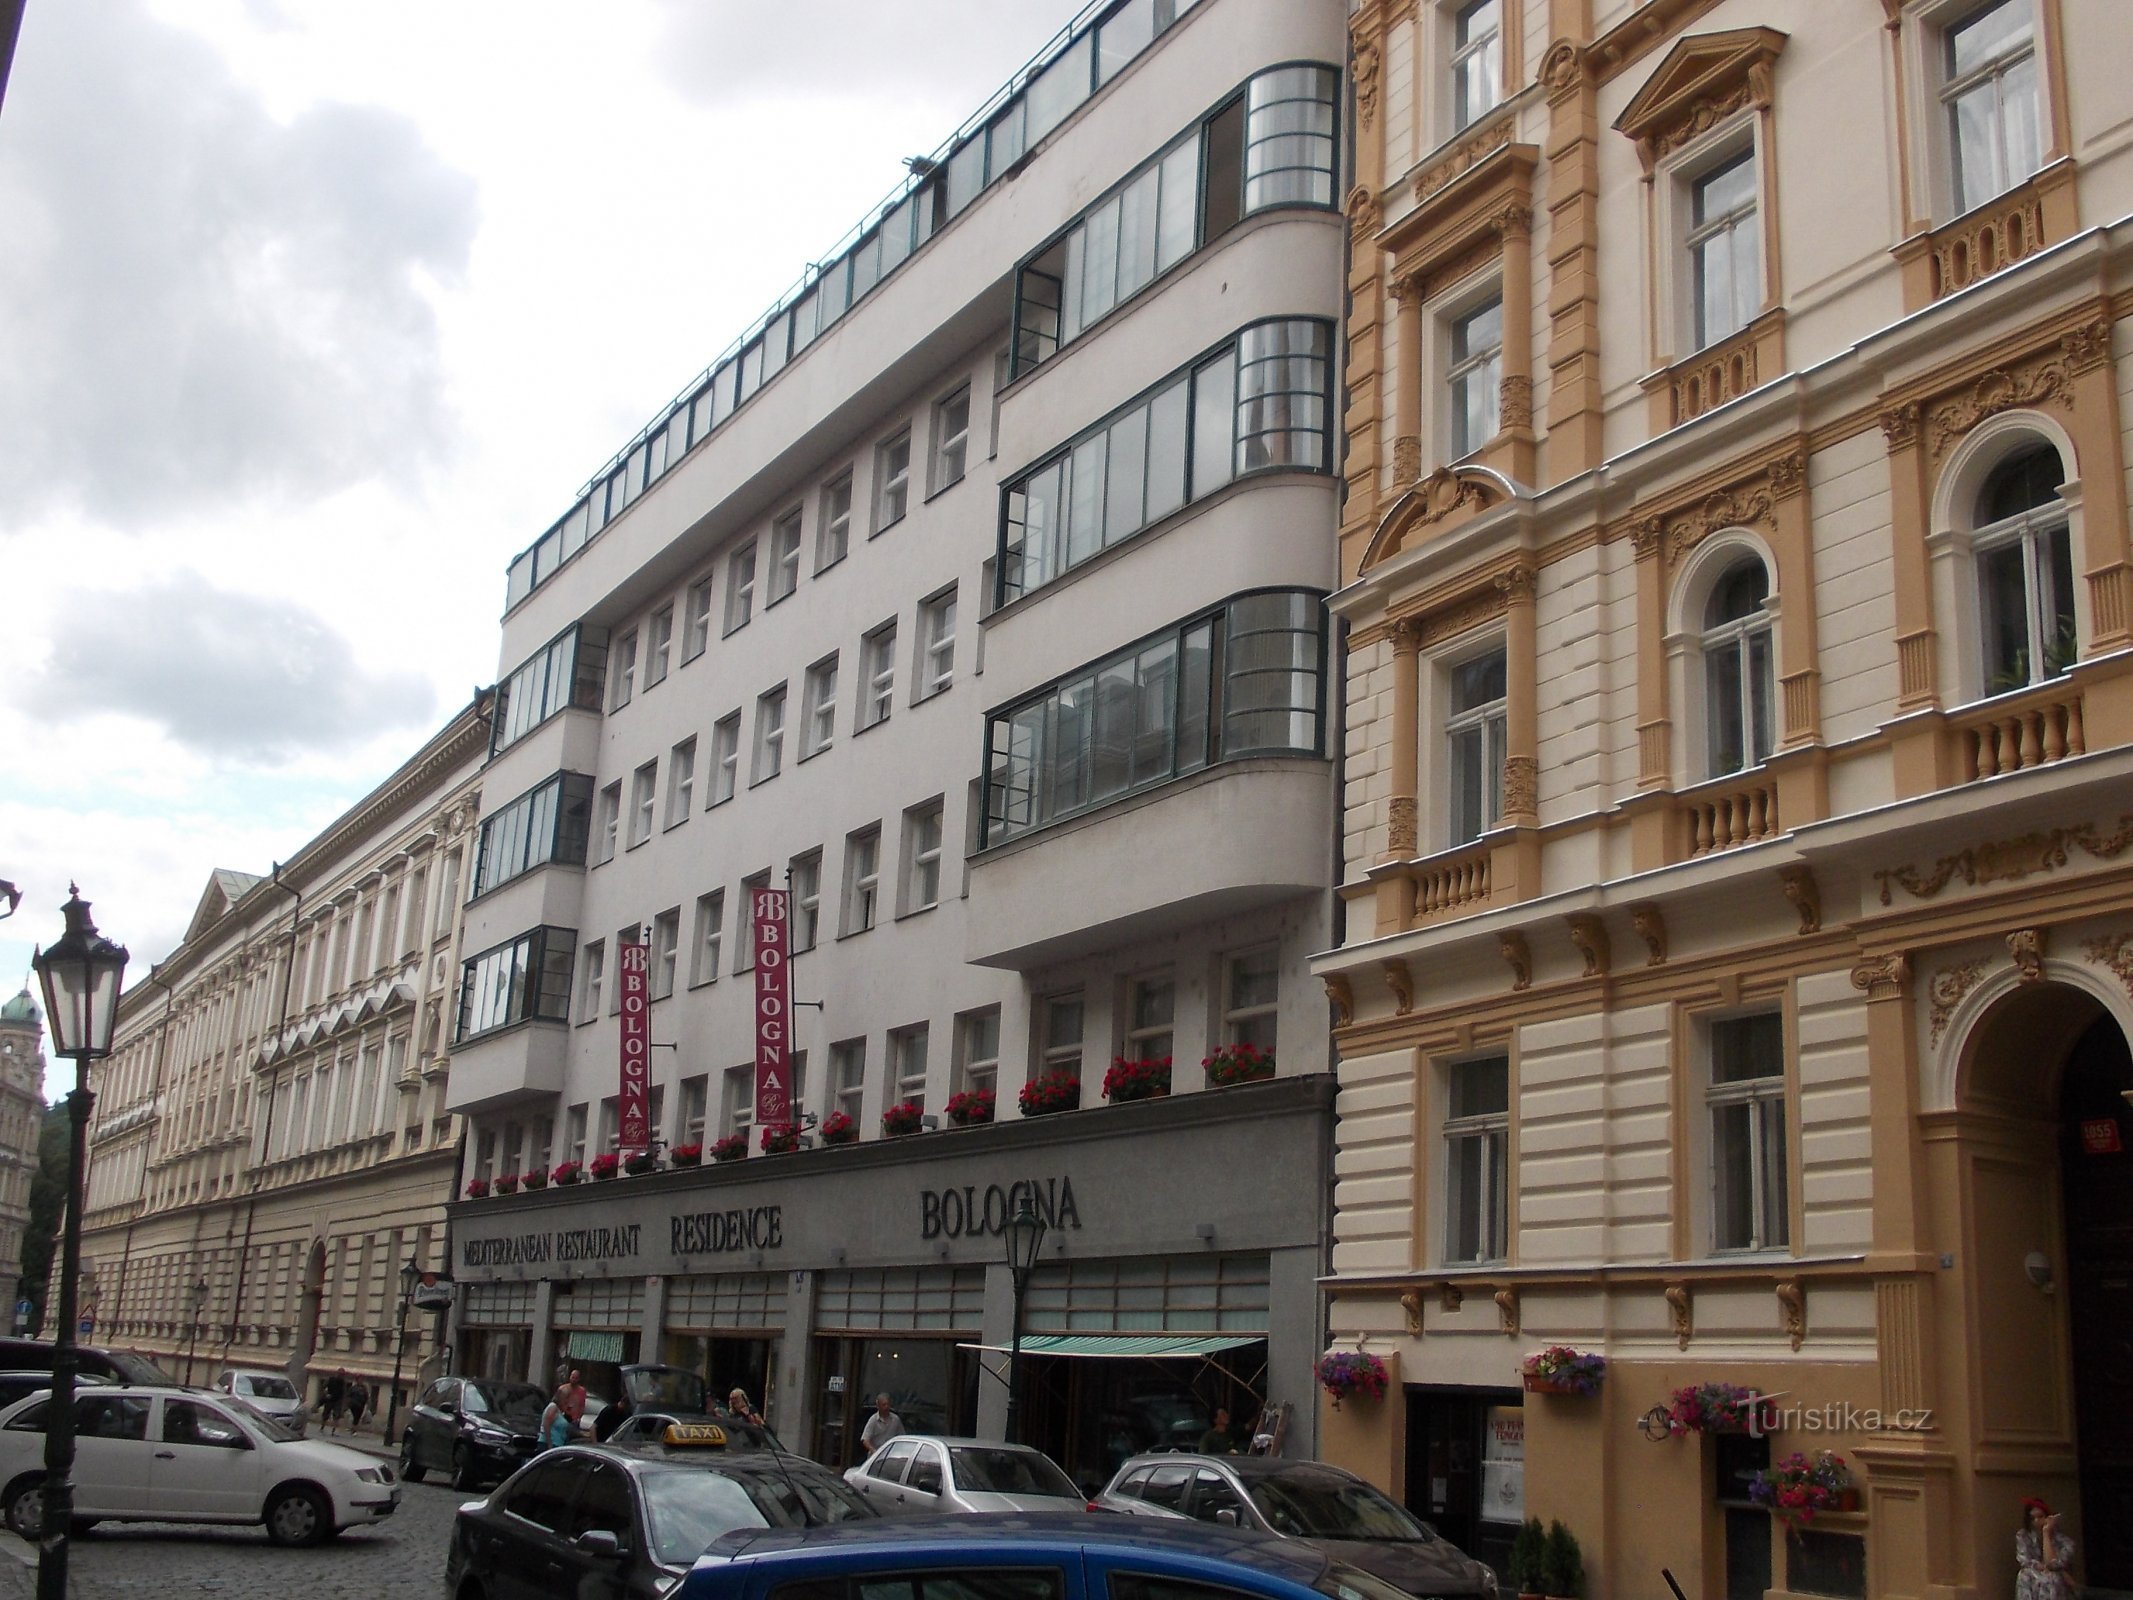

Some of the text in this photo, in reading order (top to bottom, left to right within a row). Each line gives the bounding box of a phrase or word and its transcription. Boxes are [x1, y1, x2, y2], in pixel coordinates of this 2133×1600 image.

[761, 925, 782, 1089] BOLOGNA
[625, 975, 643, 1118] BOLOGNA
[464, 1224, 641, 1266] MEDITERRANEAN RESTAURANT
[670, 1206, 783, 1255] RESIDENCE
[680, 1427, 720, 1439] TAXI
